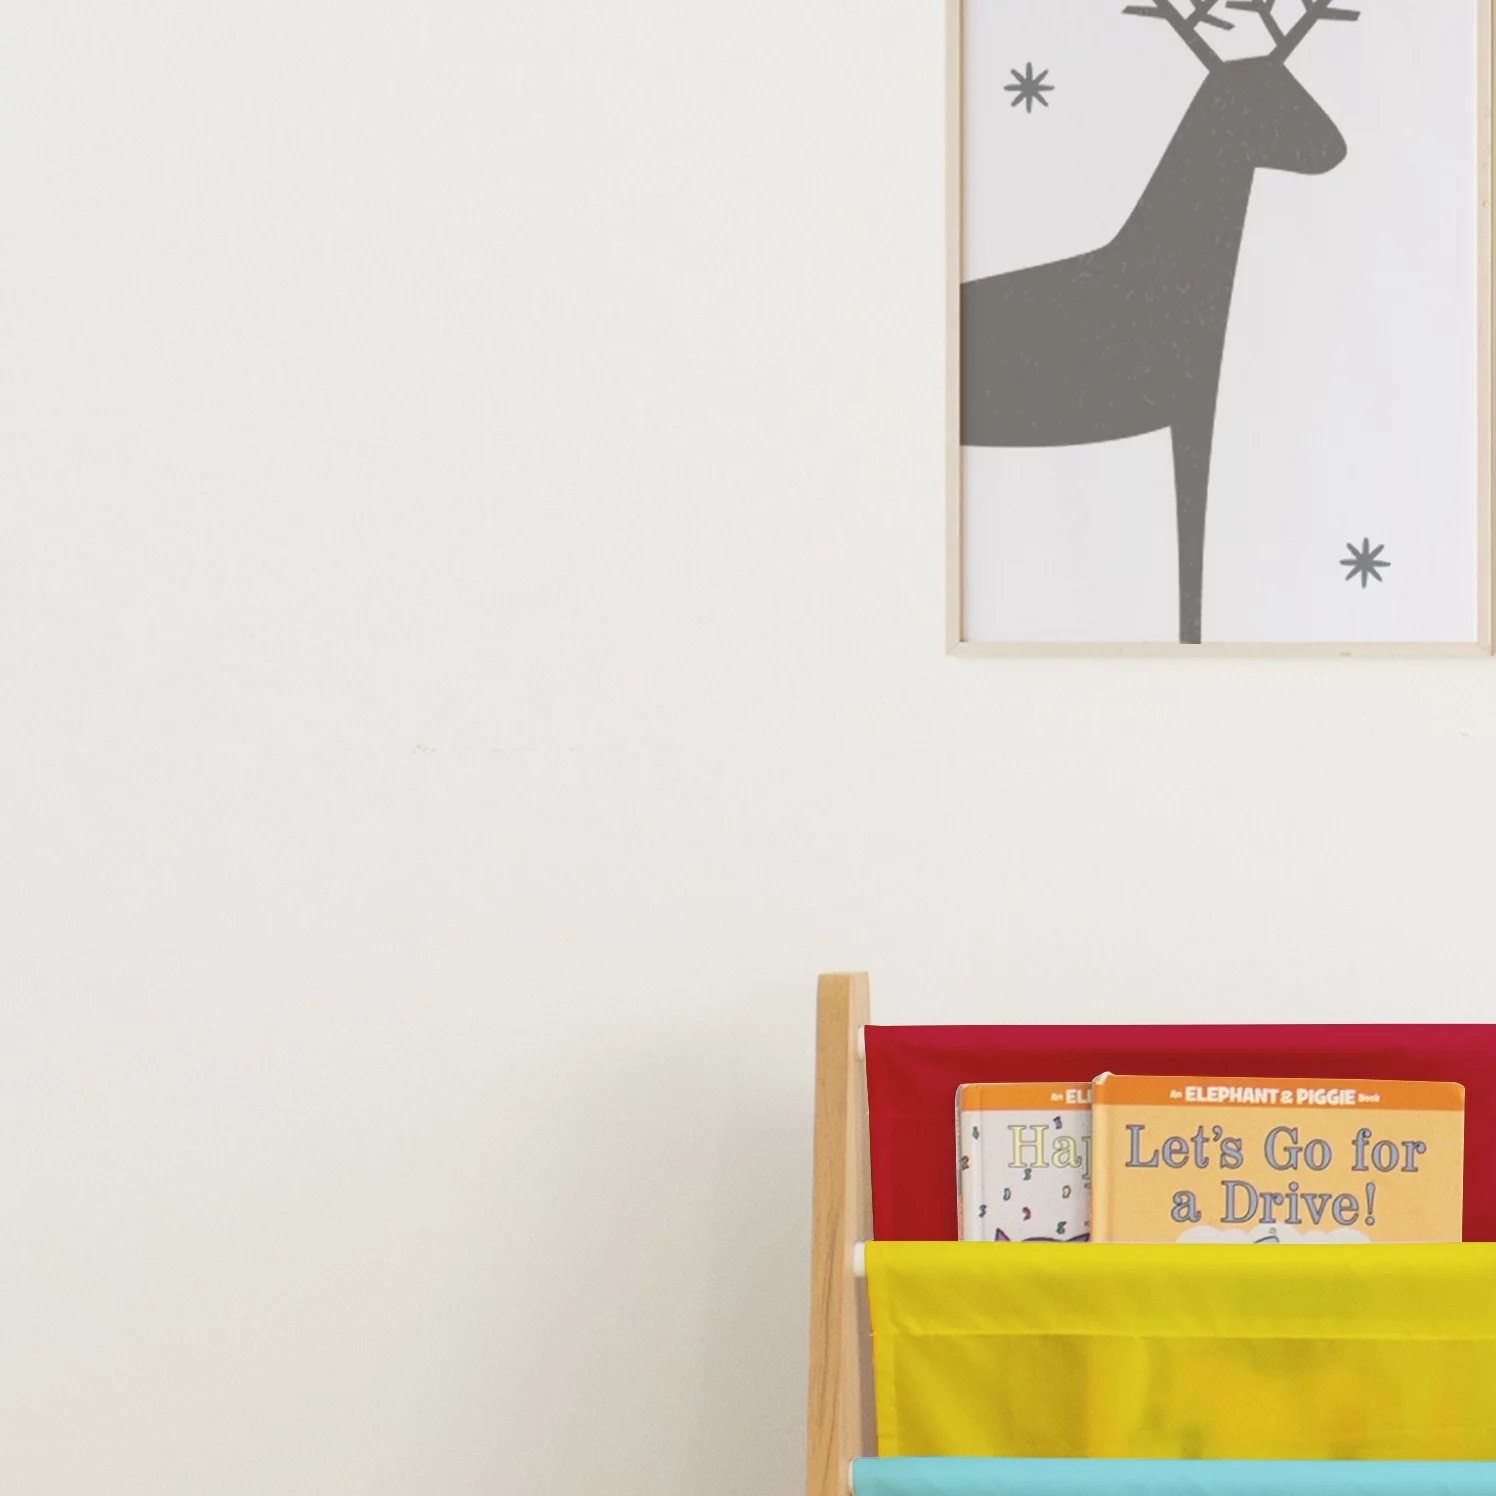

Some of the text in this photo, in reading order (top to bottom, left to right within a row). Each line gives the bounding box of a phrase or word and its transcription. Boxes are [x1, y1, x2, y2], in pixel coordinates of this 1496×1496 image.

[1185, 1086, 1279, 1104] ELEPHANT
[1280, 1089, 1293, 1104] &
[1296, 1088, 1356, 1105] PIGGIE
[1357, 1094, 1380, 1104] Book
[1125, 1124, 1427, 1172] Let’s Go for
[1170, 1180, 1376, 1226] a Drive!
